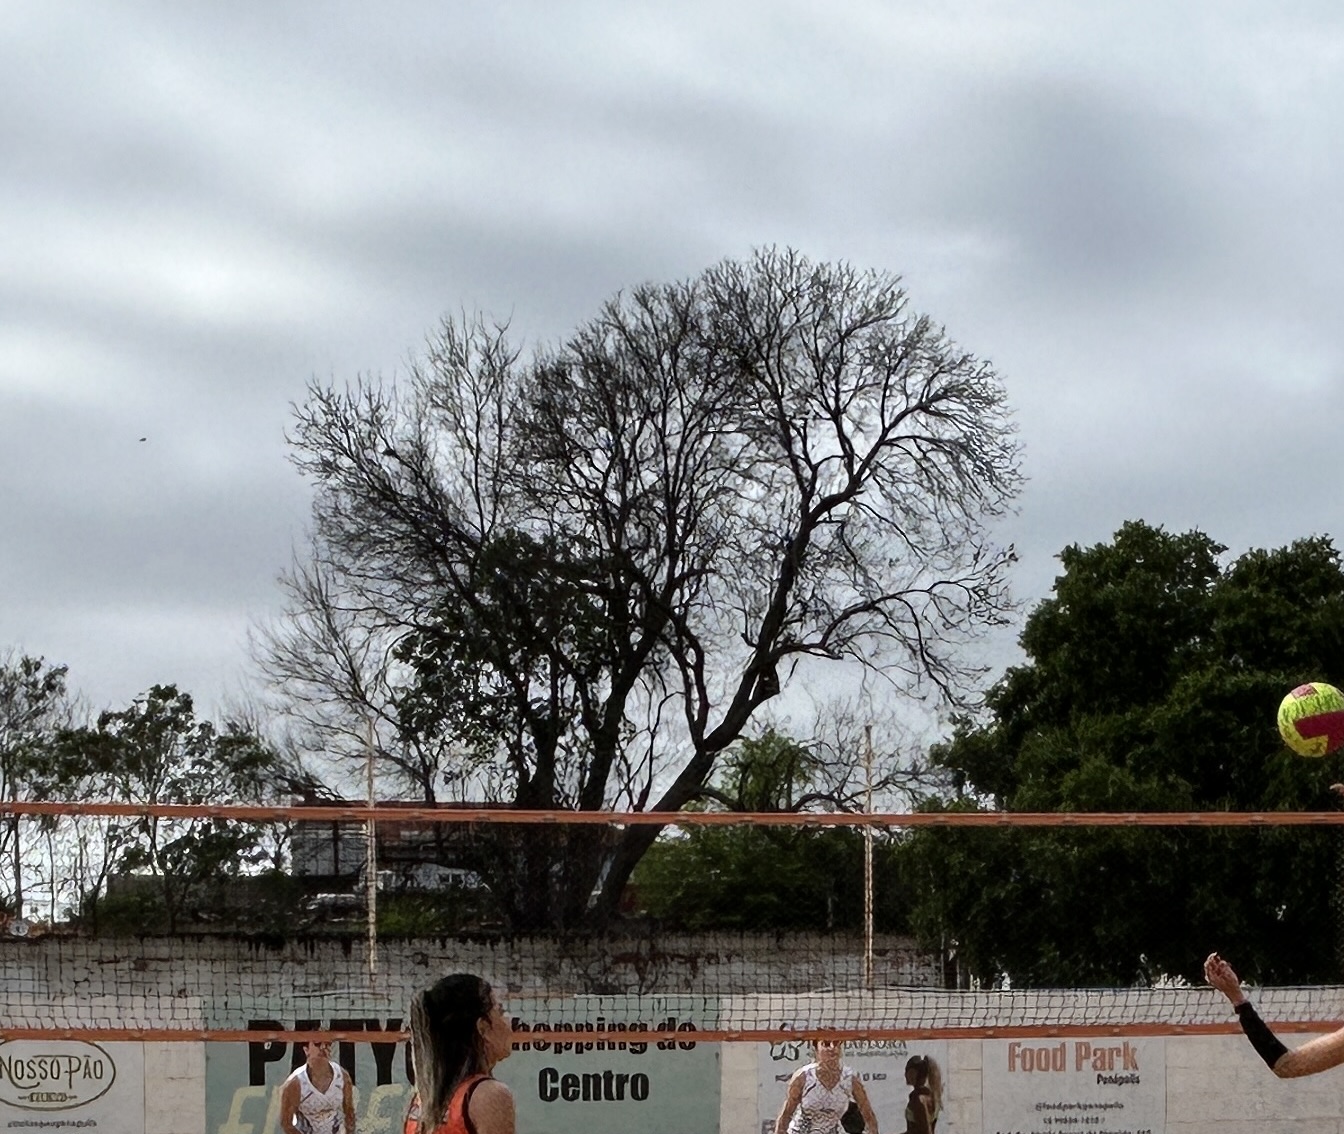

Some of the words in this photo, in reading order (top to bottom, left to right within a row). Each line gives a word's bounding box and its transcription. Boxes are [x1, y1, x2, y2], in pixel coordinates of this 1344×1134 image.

[1008, 1041, 1067, 1072] Food
[1075, 1041, 1139, 1072] Park
[538, 1067, 650, 1102] Centro
